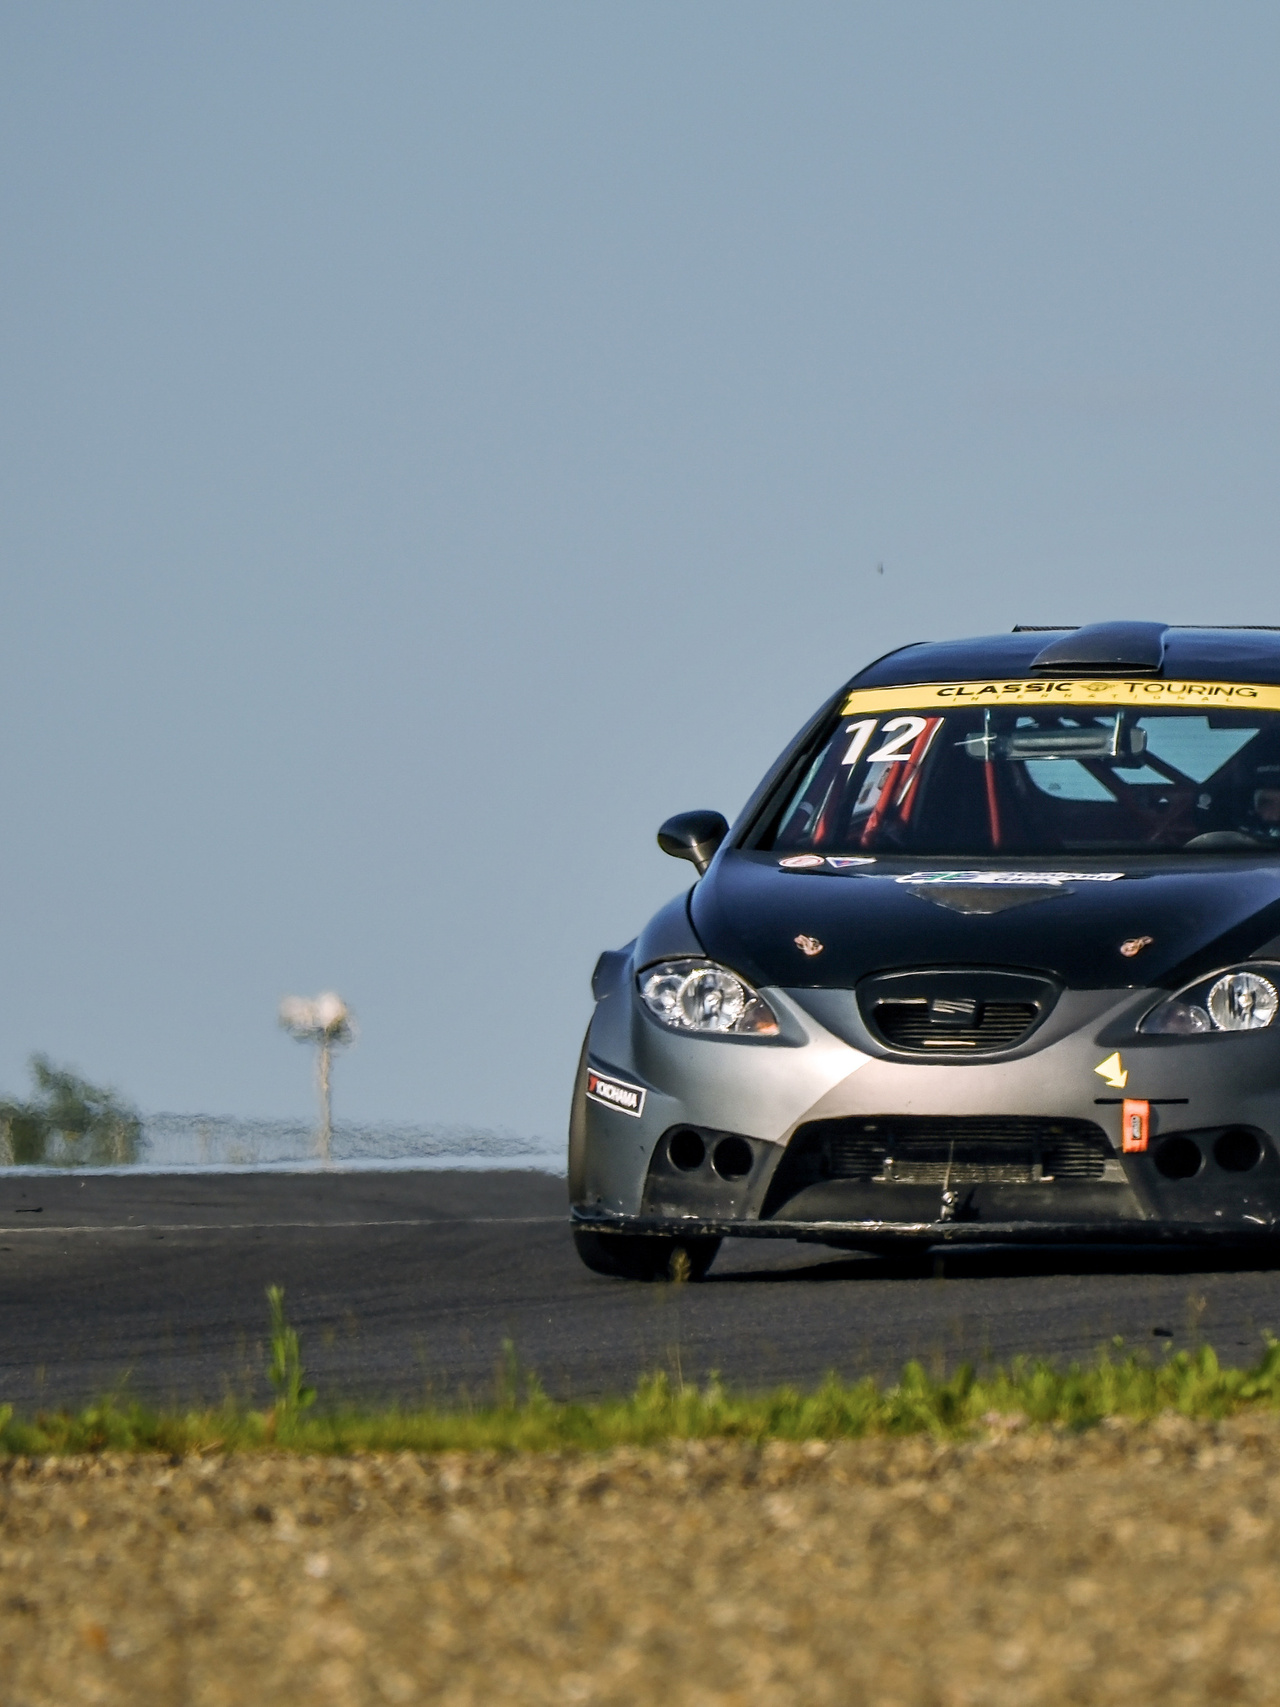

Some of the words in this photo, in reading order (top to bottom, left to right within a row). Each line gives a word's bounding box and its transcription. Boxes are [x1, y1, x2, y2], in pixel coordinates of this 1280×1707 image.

[936, 682, 1073, 697] CLASSIC
[1124, 682, 1259, 698] TOURING
[842, 716, 927, 765] 12
